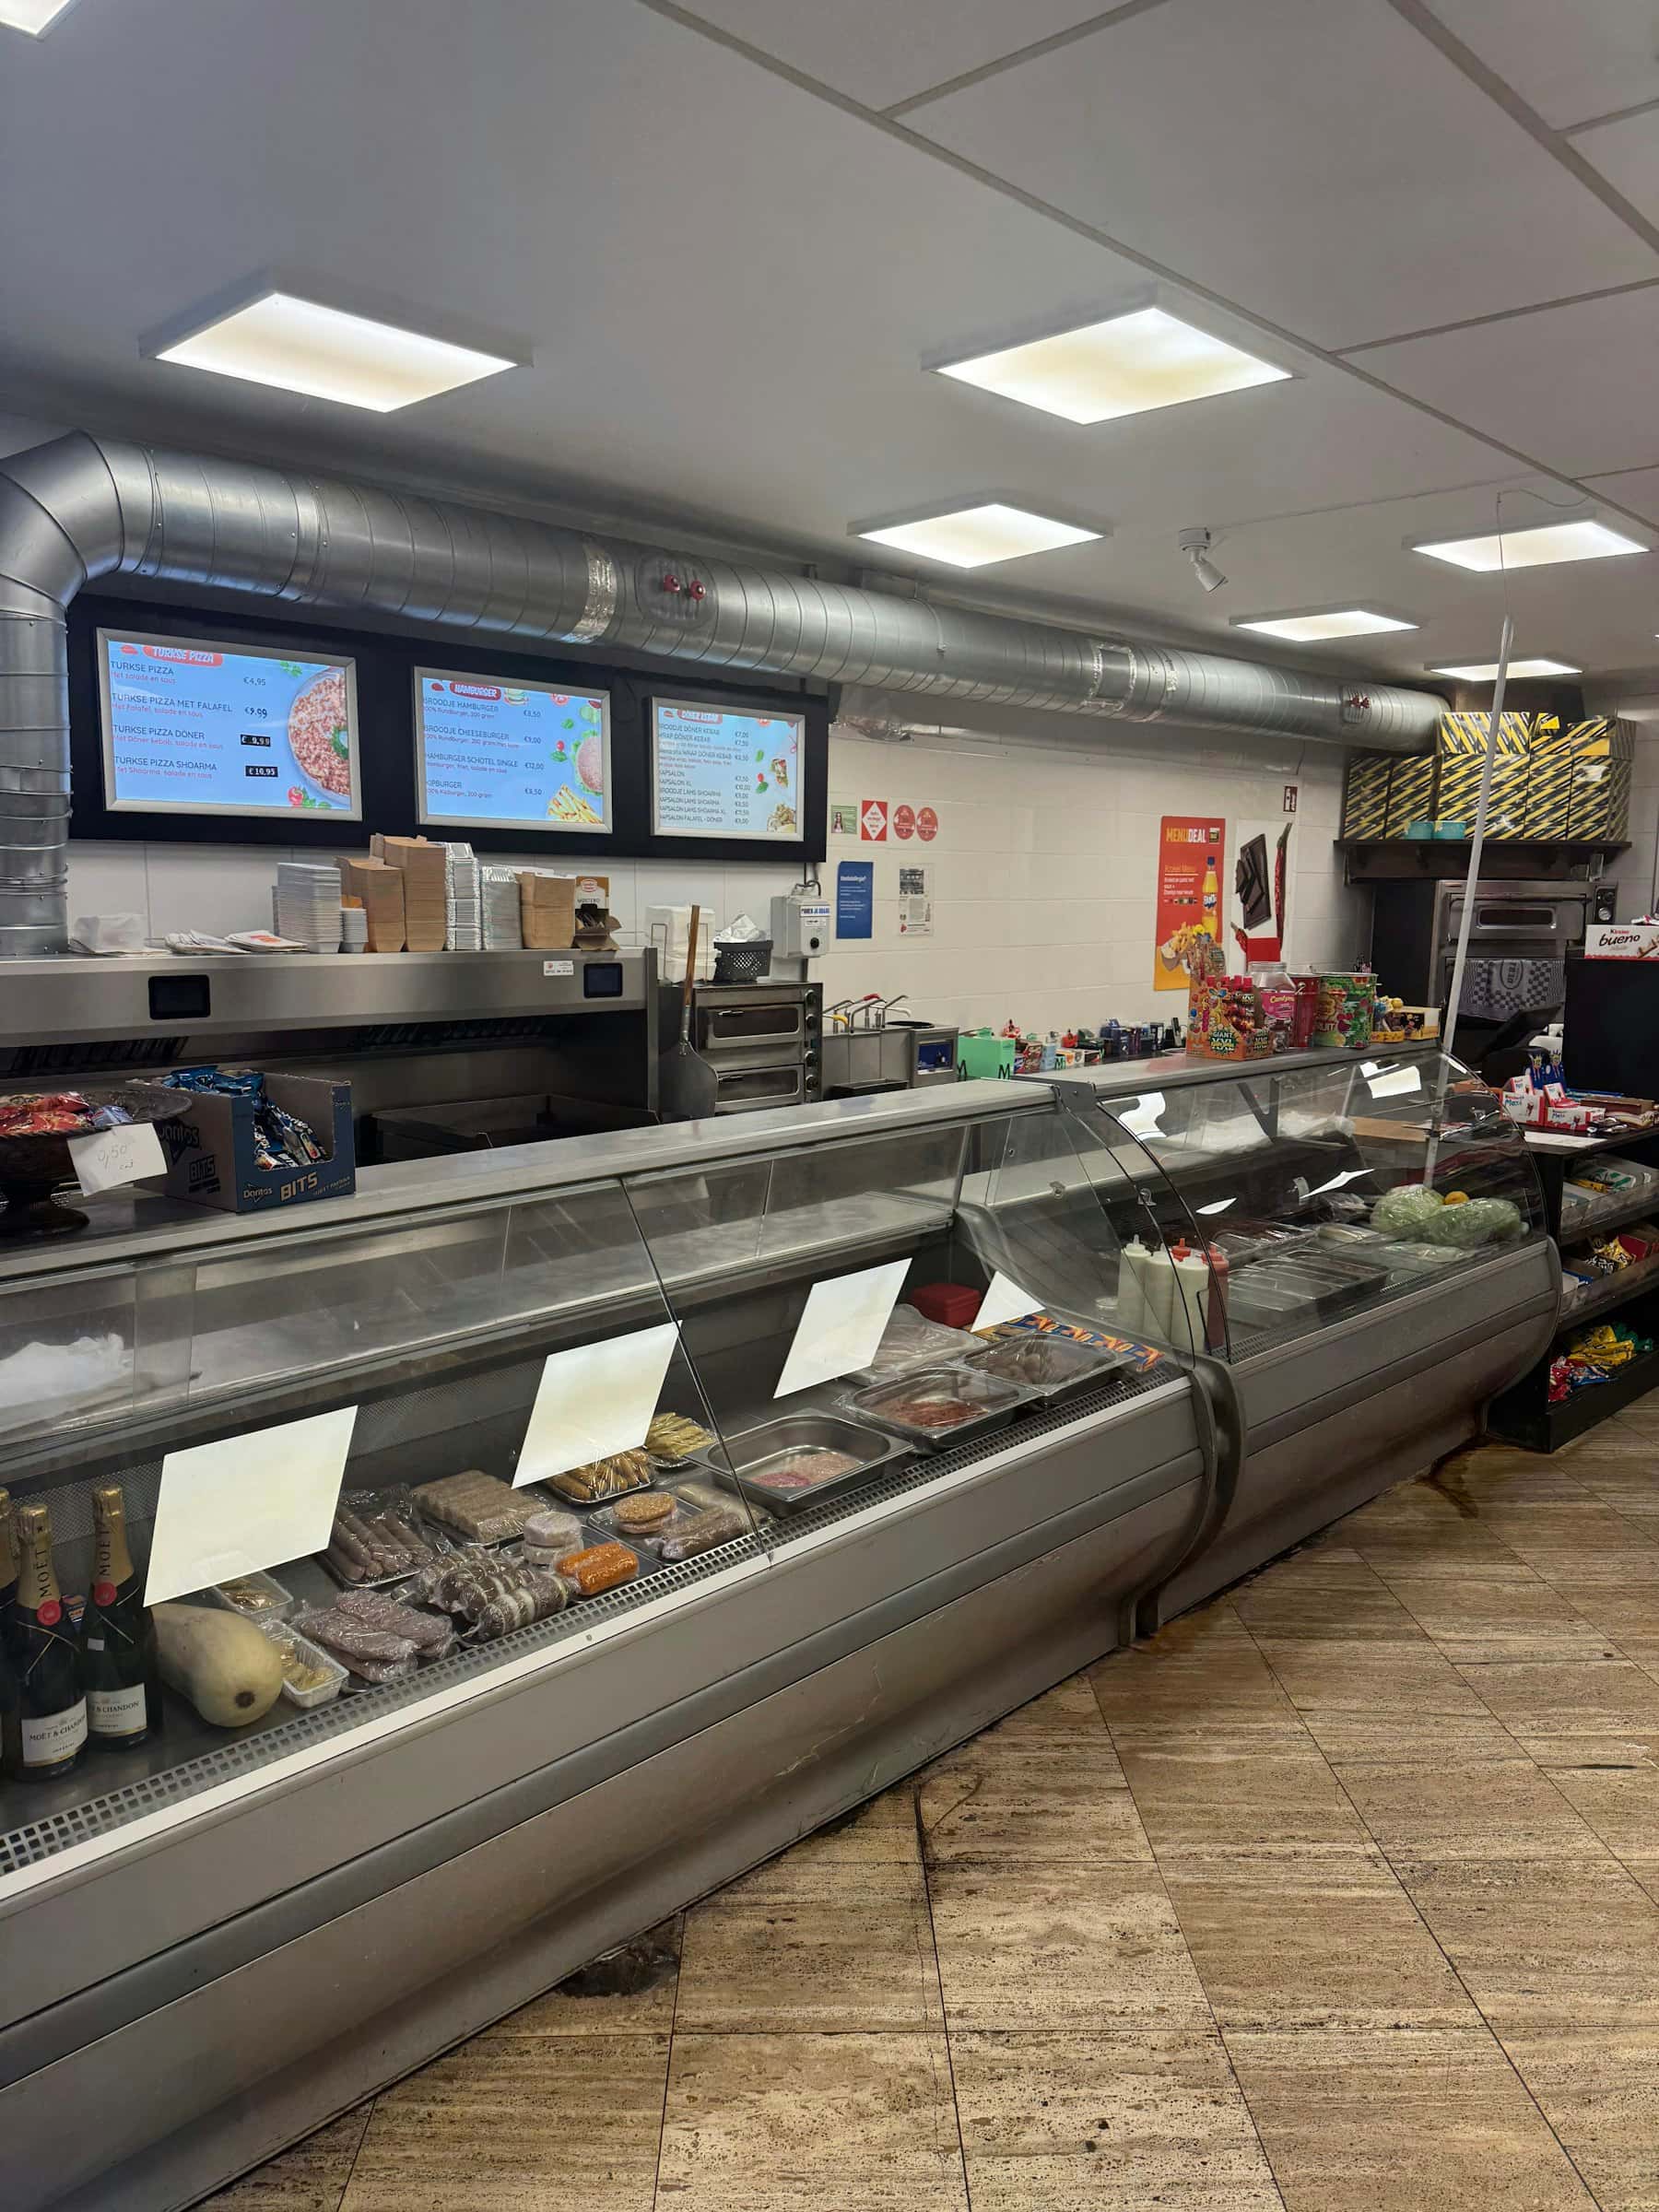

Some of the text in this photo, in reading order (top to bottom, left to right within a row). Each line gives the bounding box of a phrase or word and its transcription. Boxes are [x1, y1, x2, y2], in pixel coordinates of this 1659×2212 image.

[111, 661, 174, 676] TURKSE PIZZA
[112, 693, 232, 712] TURKSE PIZZA MET FALAFEL
[457, 700, 499, 712] HAMBURGER
[113, 724, 147, 735] TURKSE
[148, 727, 173, 736] PIZZA
[114, 756, 218, 771] TURKSE PIZZA SHOARMA
[1598, 933, 1641, 947] bueno
[243, 1186, 273, 1199] Doritos
[280, 1172, 318, 1202] BITS
[102, 1700, 141, 1712] CHANDON
